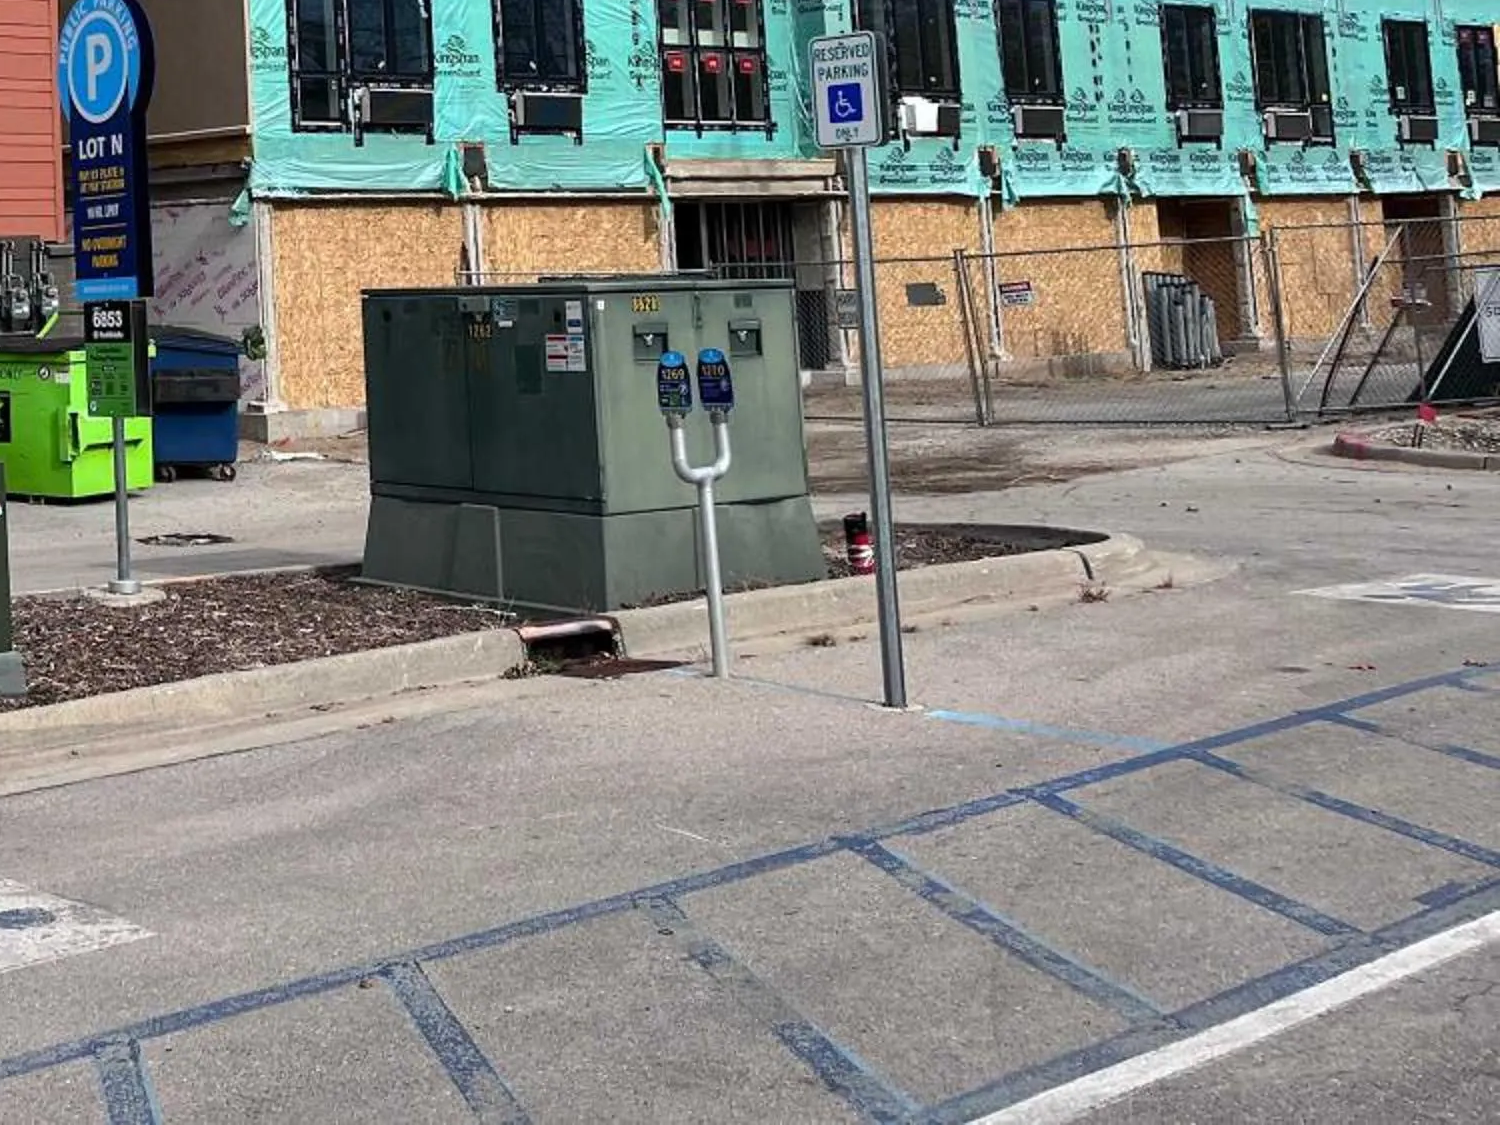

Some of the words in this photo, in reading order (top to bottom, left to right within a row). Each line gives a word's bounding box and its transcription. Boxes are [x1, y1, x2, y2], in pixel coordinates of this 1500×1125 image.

[814, 43, 870, 62] RESERVED
[87, 34, 113, 102] P
[817, 62, 870, 81] PARKING
[79, 136, 106, 160] LOT
[111, 133, 123, 156] N
